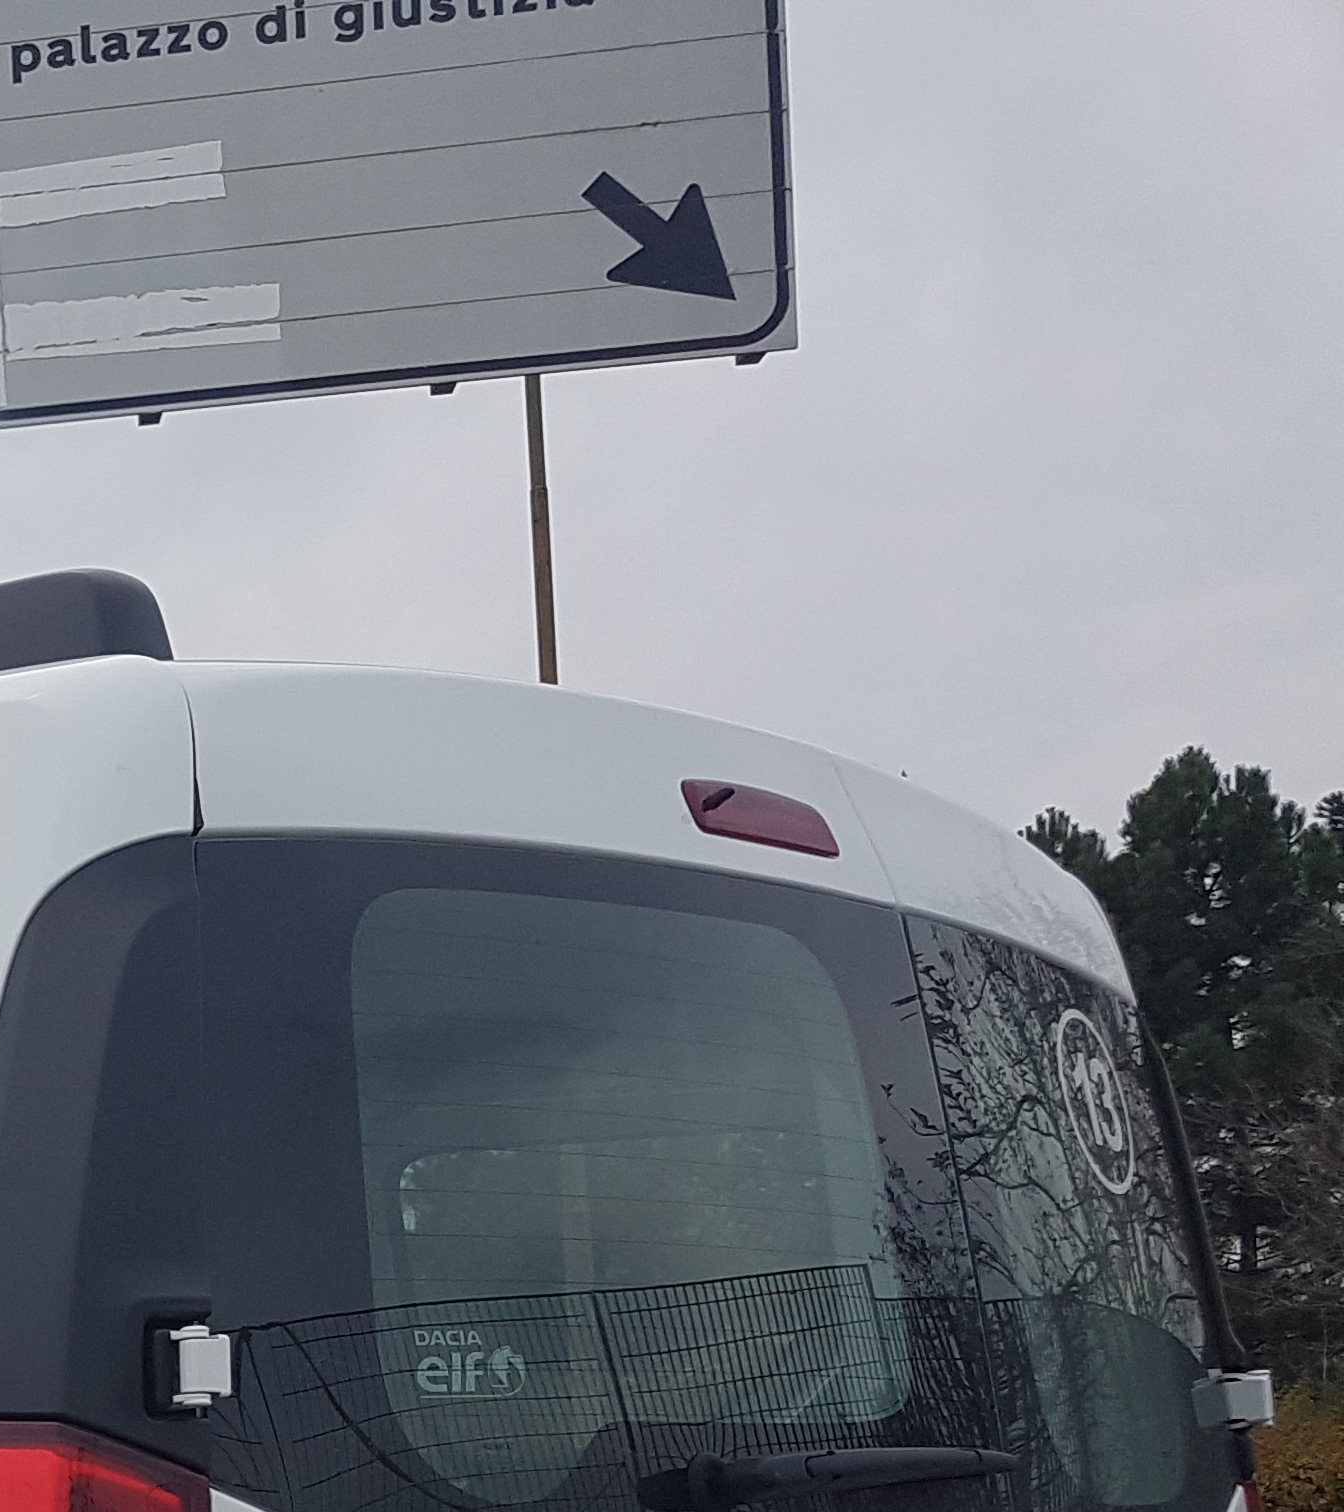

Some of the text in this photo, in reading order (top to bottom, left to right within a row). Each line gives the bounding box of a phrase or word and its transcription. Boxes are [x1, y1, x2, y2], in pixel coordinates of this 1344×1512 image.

[10, 0, 596, 83] palazzo di giust
[1073, 1052, 1124, 1153] 13
[414, 1329, 482, 1347] DACIA
[416, 1351, 485, 1393] elf
